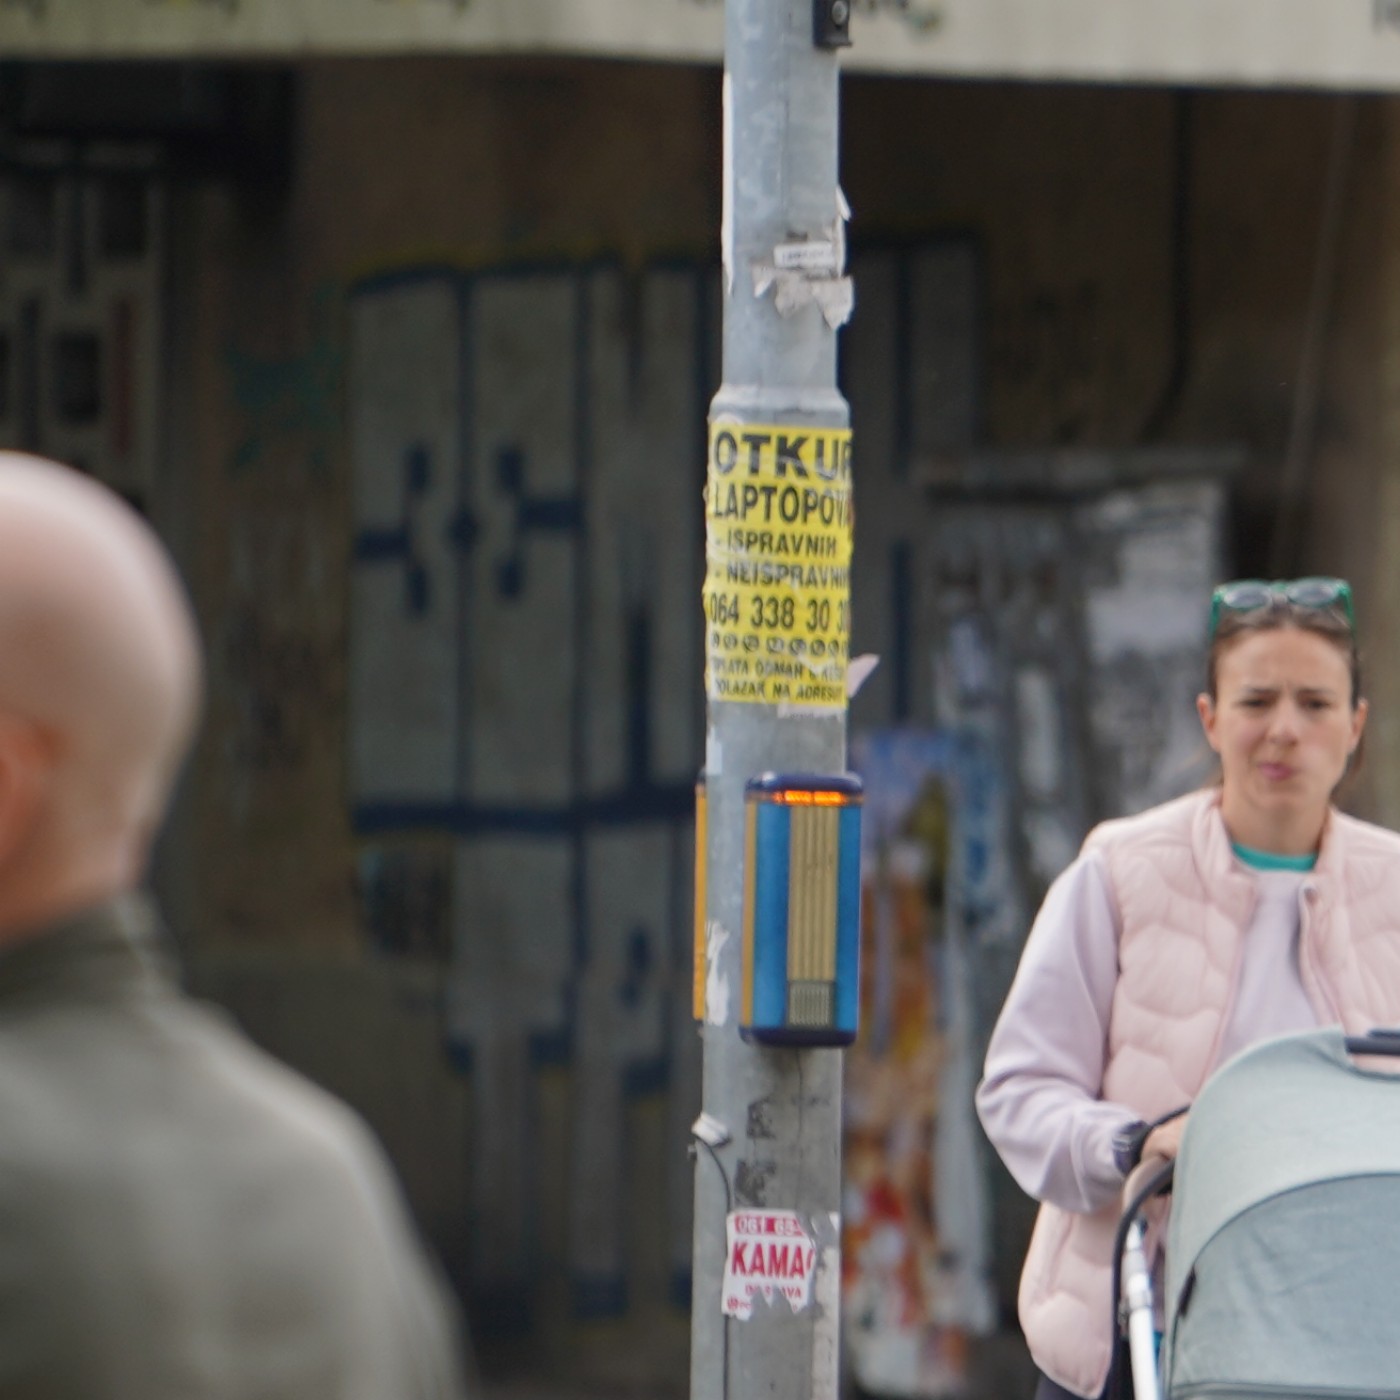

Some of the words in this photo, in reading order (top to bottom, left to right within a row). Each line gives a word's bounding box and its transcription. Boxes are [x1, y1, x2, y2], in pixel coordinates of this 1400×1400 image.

[751, 597, 795, 630] 338
[806, 600, 831, 632] 30
[732, 1241, 815, 1279] KAMA
